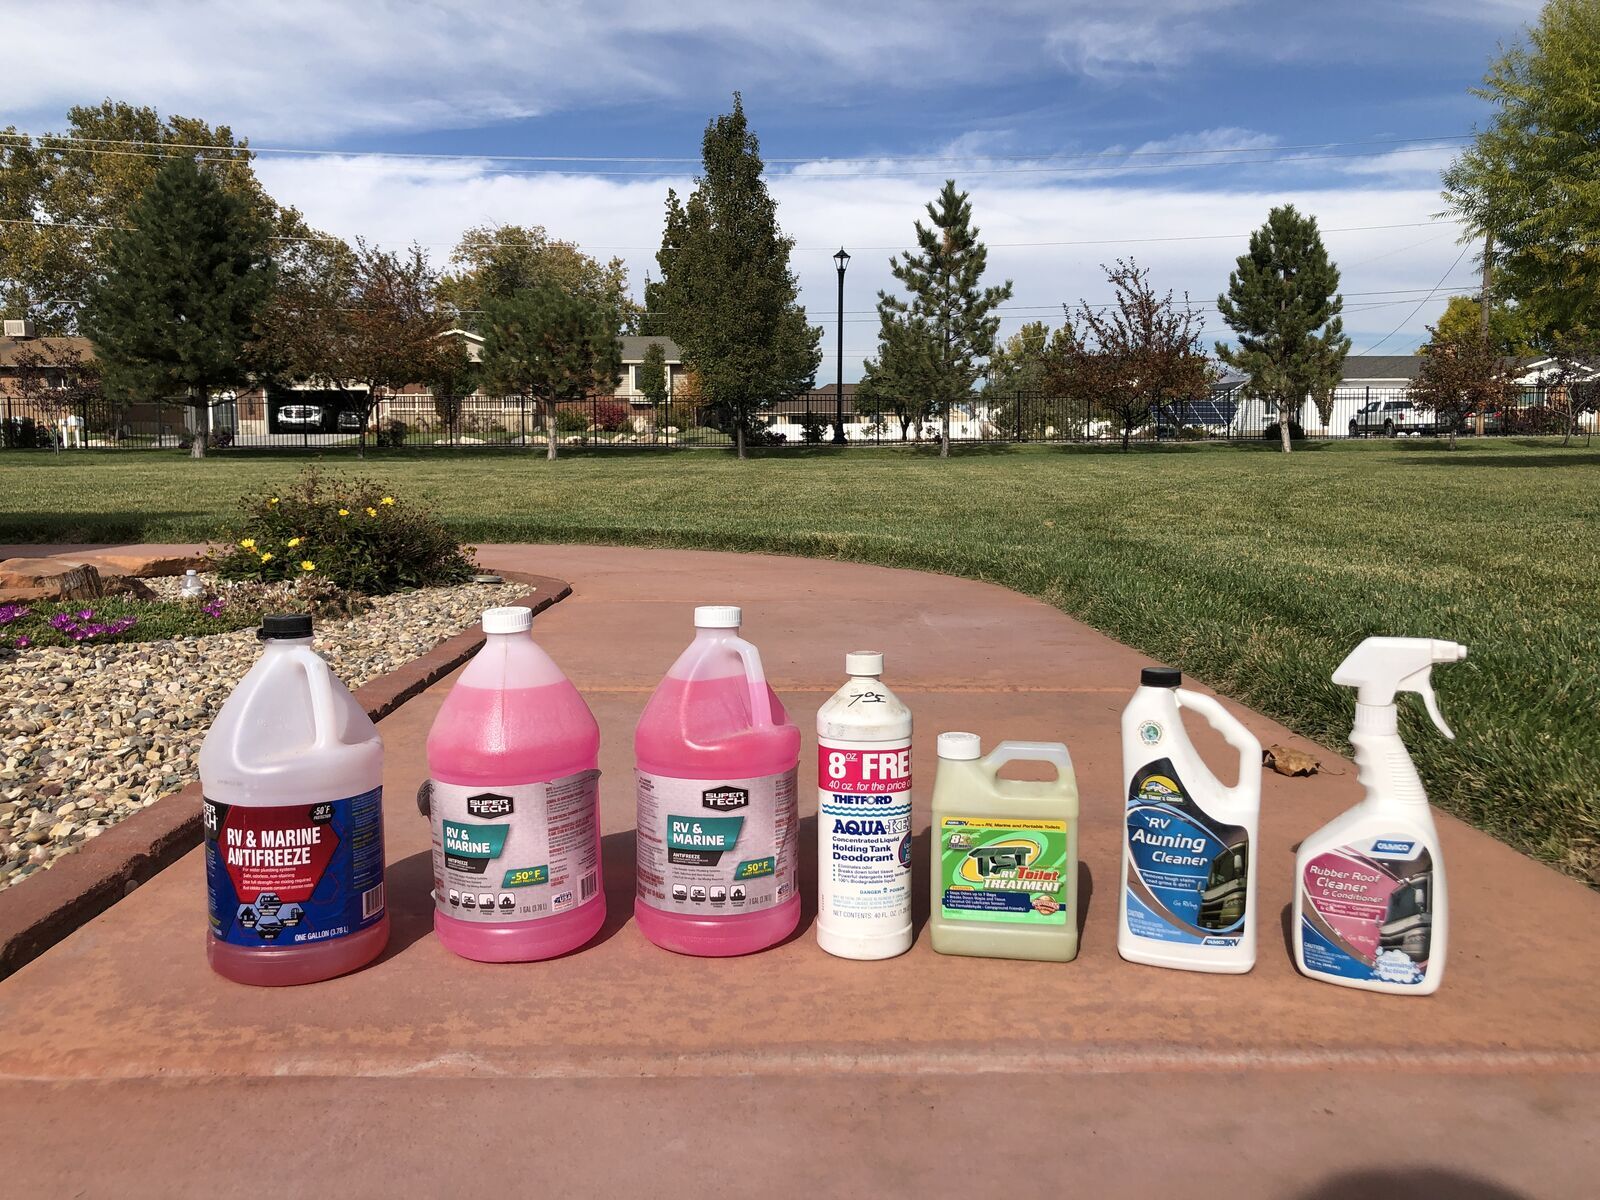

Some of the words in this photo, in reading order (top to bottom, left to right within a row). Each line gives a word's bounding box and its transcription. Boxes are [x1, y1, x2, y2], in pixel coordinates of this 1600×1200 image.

[828, 752, 846, 779] 8
[828, 780, 840, 789] 40
[842, 782, 854, 790] oz.
[856, 782, 870, 791] for
[871, 782, 886, 791] the
[886, 780, 906, 792] price
[832, 794, 892, 805] THETFORD
[673, 822, 689, 832] RV
[692, 823, 702, 834] &
[1149, 817, 1171, 829] RV
[227, 828, 242, 846] RV
[246, 830, 256, 848] &
[262, 826, 321, 848] MARINE
[446, 826, 459, 838] RV
[461, 830, 470, 840] &
[950, 834, 960, 844] 8
[447, 838, 491, 853] MARINE
[673, 834, 724, 846] MARINE
[1132, 829, 1206, 853] Awning
[832, 844, 868, 854] Holding
[1376, 843, 1409, 851] CAMCO
[228, 847, 311, 866] ANTIFREEZE
[832, 852, 894, 862] Deodorant
[1152, 851, 1208, 866] Cleaner
[1017, 866, 1060, 881] Toilet
[1310, 865, 1350, 879] Rubber
[1352, 872, 1380, 882] Roof
[984, 879, 1062, 892] TREATMENT
[1316, 877, 1368, 893] Cleaner
[1332, 890, 1383, 903] Conditioner
[1182, 901, 1198, 910] RVing
[295, 934, 306, 942] ONE
[308, 930, 330, 940] GALLON
